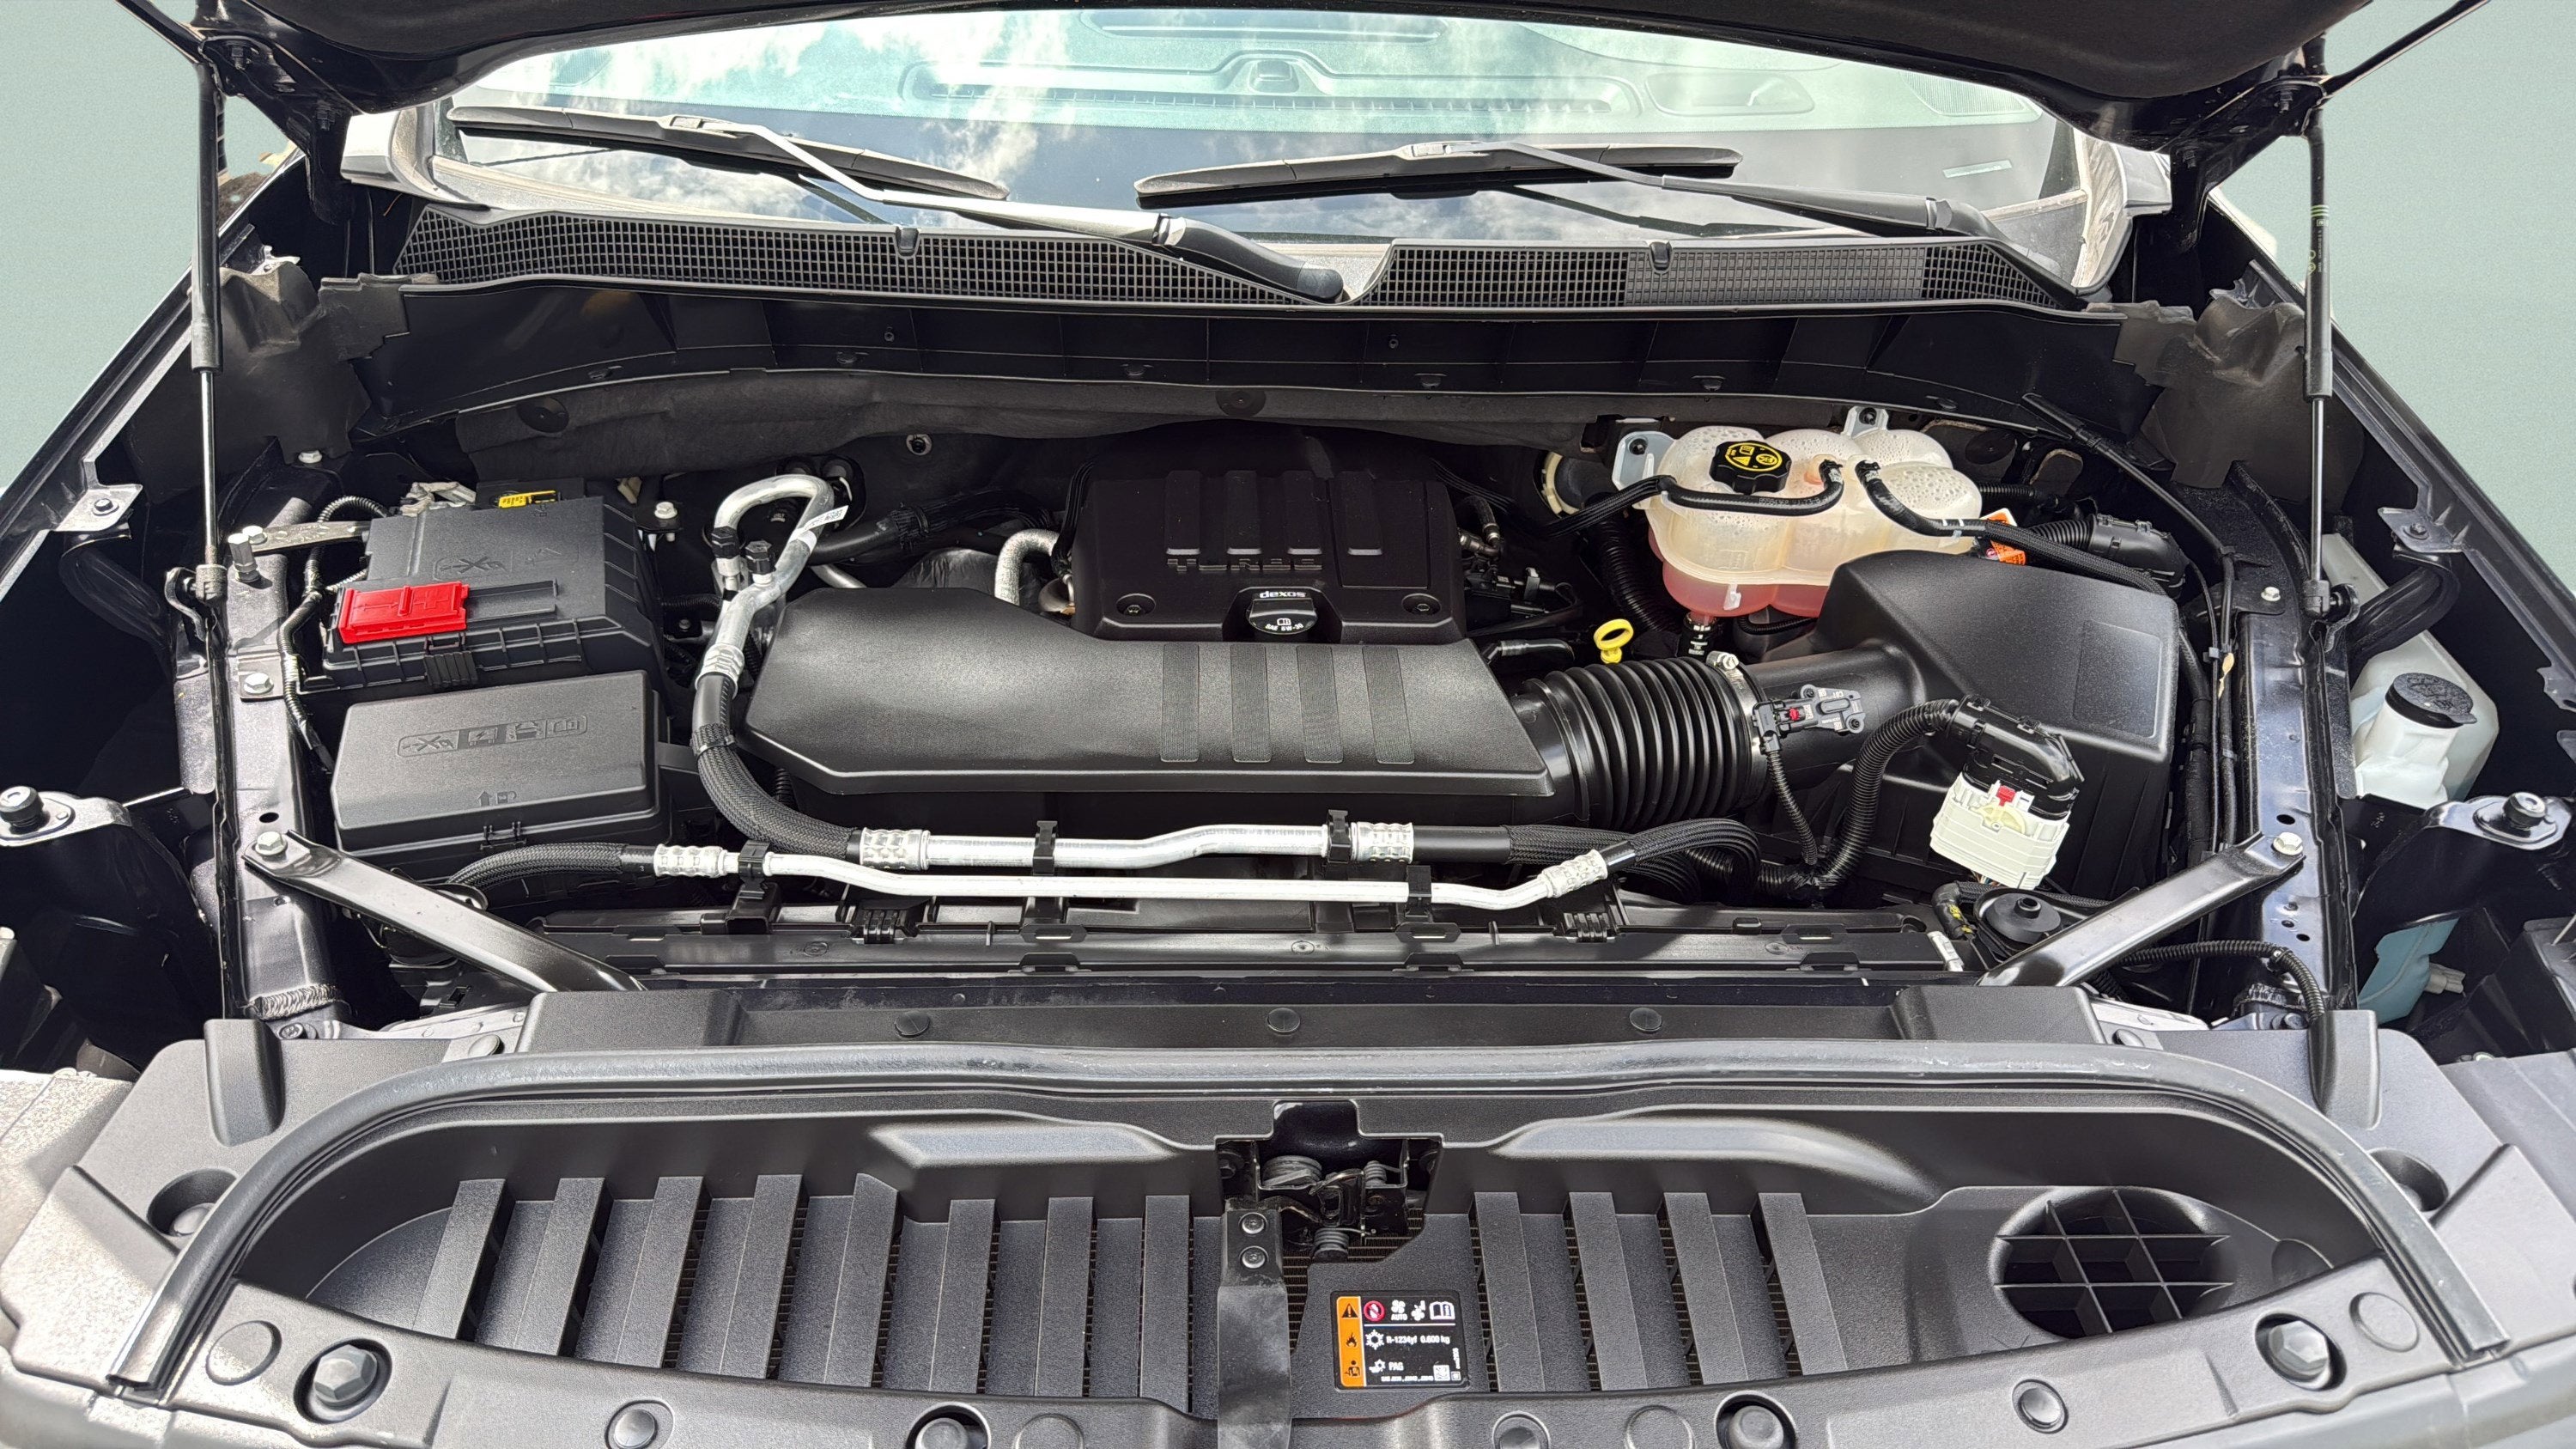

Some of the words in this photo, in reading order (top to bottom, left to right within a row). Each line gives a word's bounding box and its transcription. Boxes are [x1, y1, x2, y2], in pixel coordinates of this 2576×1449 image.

[1281, 623, 1304, 631] 5W-30
[1386, 1336, 1417, 1345] R-1234yf
[1419, 1335, 1440, 1343] 0.600
[1441, 1335, 1450, 1344] kg
[1388, 1361, 1403, 1371] PAG
